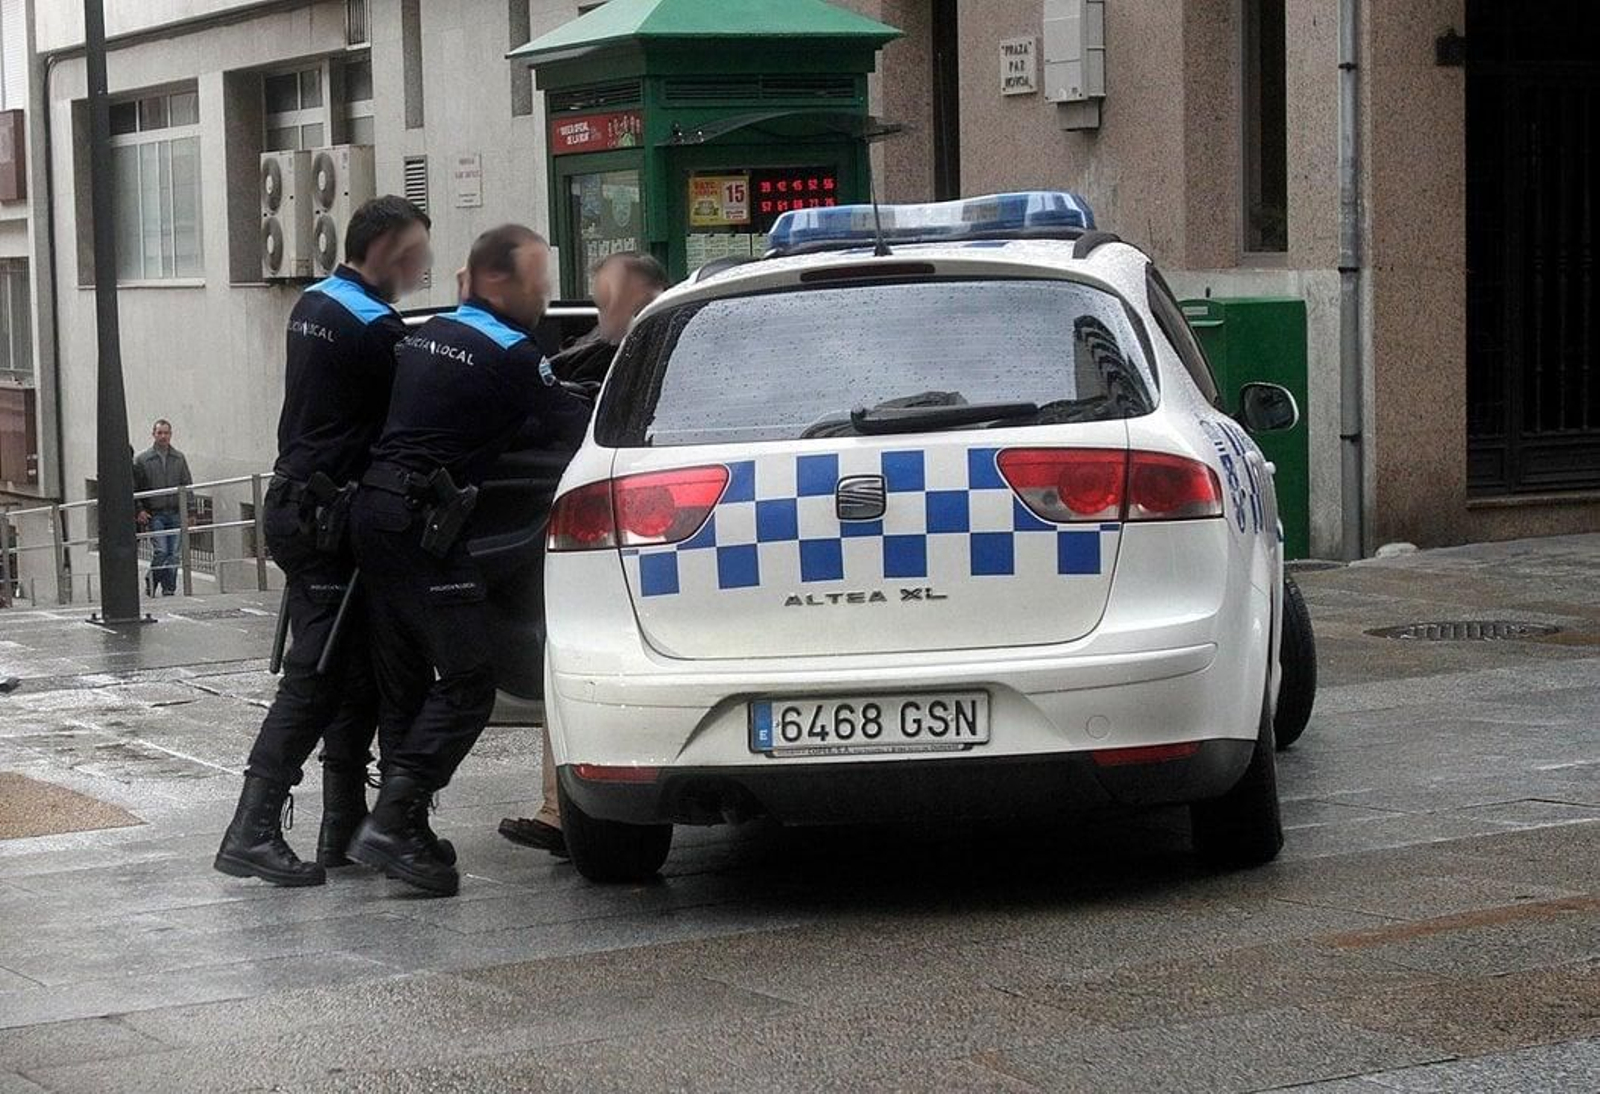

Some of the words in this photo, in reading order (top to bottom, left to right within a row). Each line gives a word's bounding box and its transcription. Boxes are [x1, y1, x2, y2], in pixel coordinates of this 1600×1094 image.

[726, 184, 745, 203] 15
[436, 344, 475, 366] LOCAL
[784, 590, 888, 607] ALTEA
[900, 587, 949, 602] XL
[780, 702, 883, 743] 6468
[900, 699, 978, 738] GSN
[759, 729, 768, 741] E
